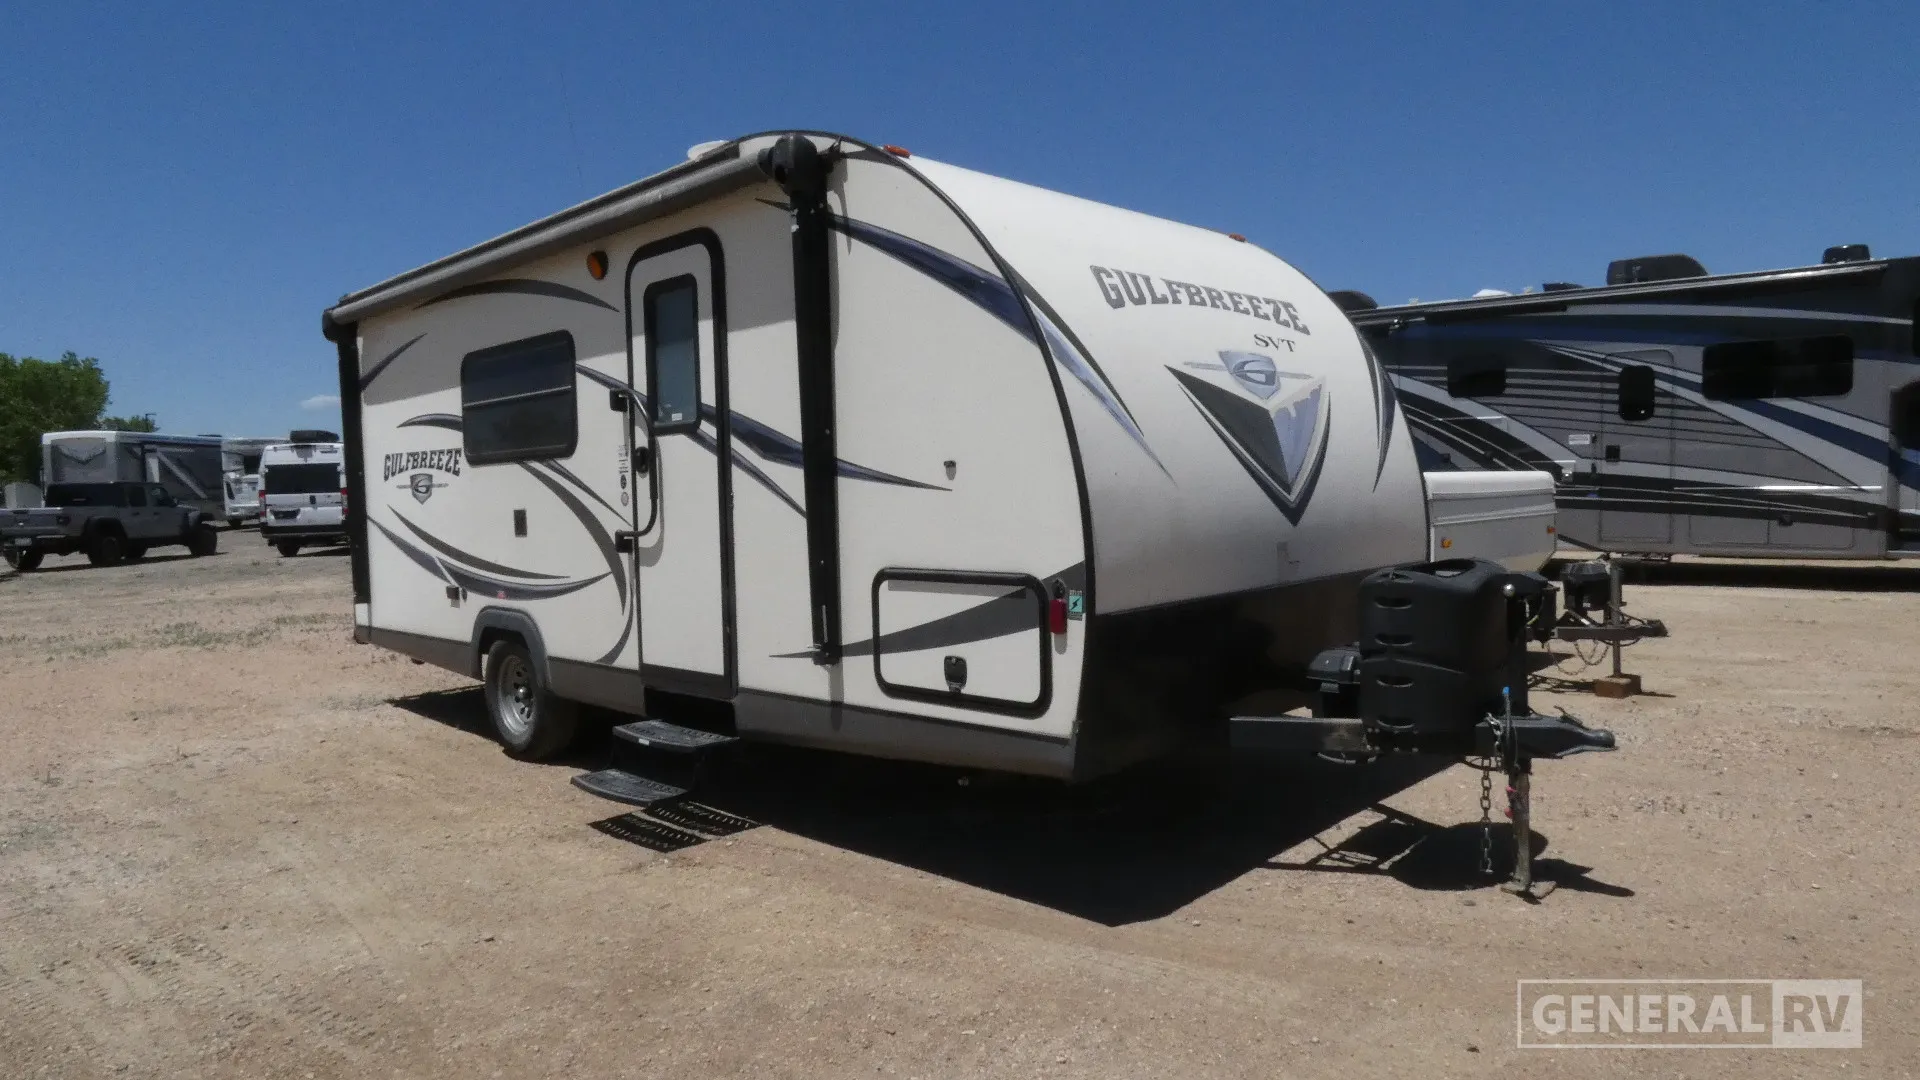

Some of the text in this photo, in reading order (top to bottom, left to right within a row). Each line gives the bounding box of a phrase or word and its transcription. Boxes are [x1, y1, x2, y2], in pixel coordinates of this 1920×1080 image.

[1089, 264, 1311, 336] GULFBREEZE
[1253, 333, 1296, 353] SVT
[383, 447, 462, 482] GULFBREEZE
